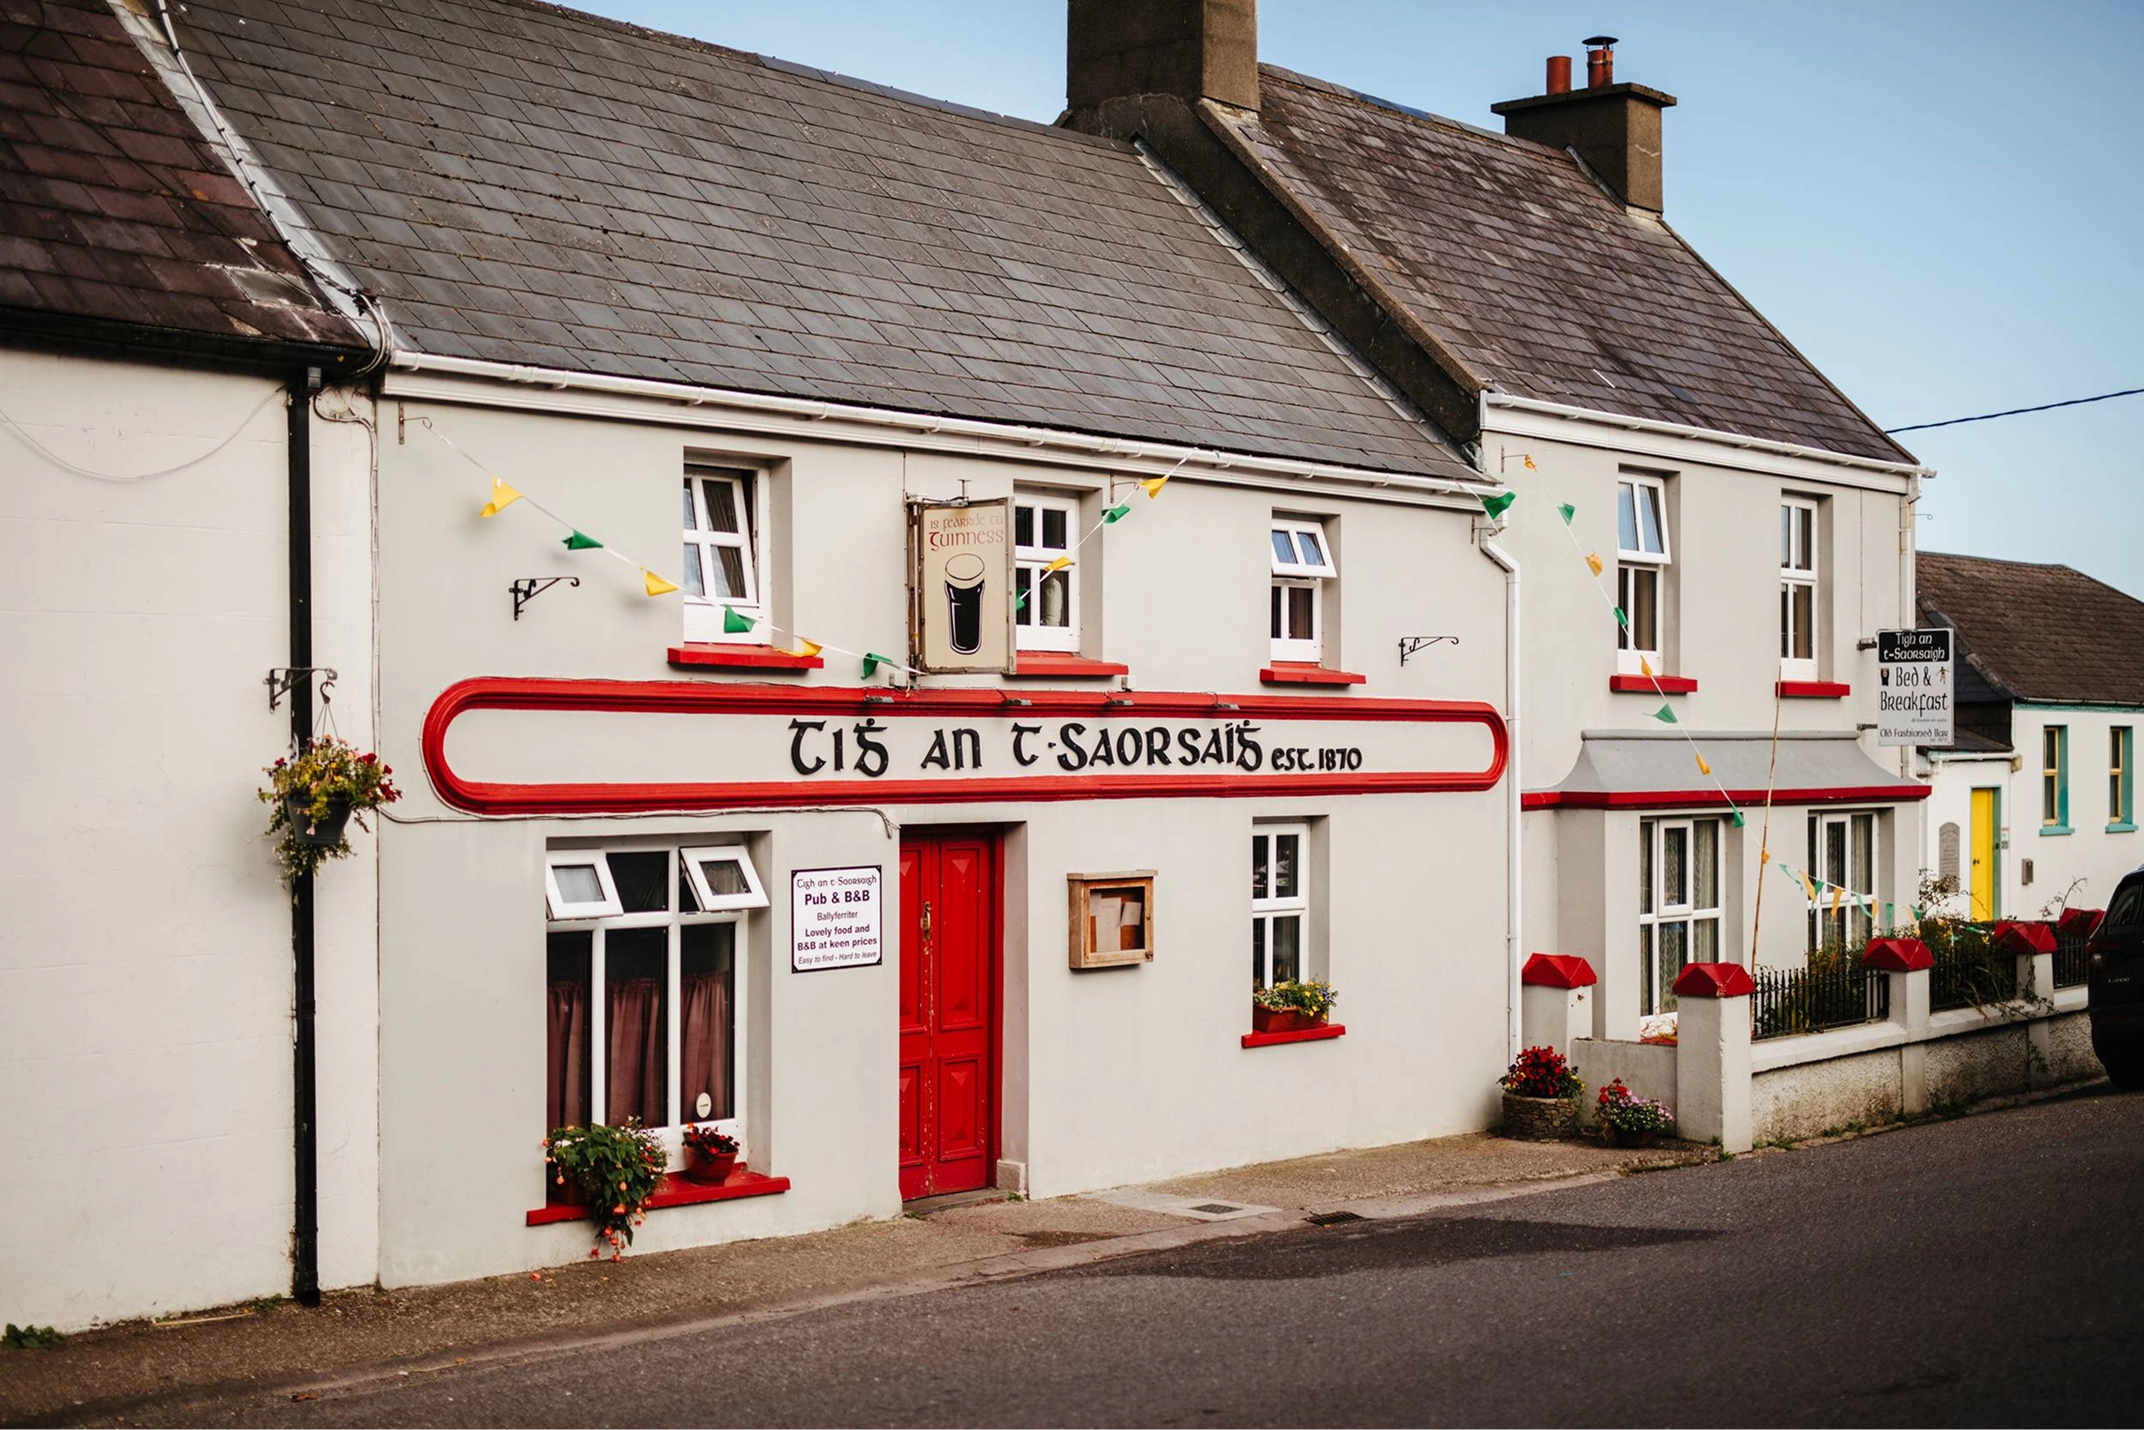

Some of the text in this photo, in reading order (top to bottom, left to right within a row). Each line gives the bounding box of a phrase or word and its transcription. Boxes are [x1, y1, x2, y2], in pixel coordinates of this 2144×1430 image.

[928, 529, 1004, 552] Guinness
[1895, 632, 1933, 648] Tigh an
[1883, 646, 1946, 662] t-Saorsaigh
[1896, 666, 1931, 686] Bed &
[1880, 690, 1948, 717] Breakfast
[1880, 728, 1949, 737] Old Fashioned Bar
[817, 879, 828, 887] an
[804, 890, 870, 906] Pub & B&B
[816, 910, 858, 923] Ballyferriter
[805, 924, 870, 938] Lovely food and
[797, 937, 878, 951] B&B at keen prices
[798, 956, 814, 965] Easy
[822, 954, 834, 962] find
[839, 952, 853, 960] Hard
